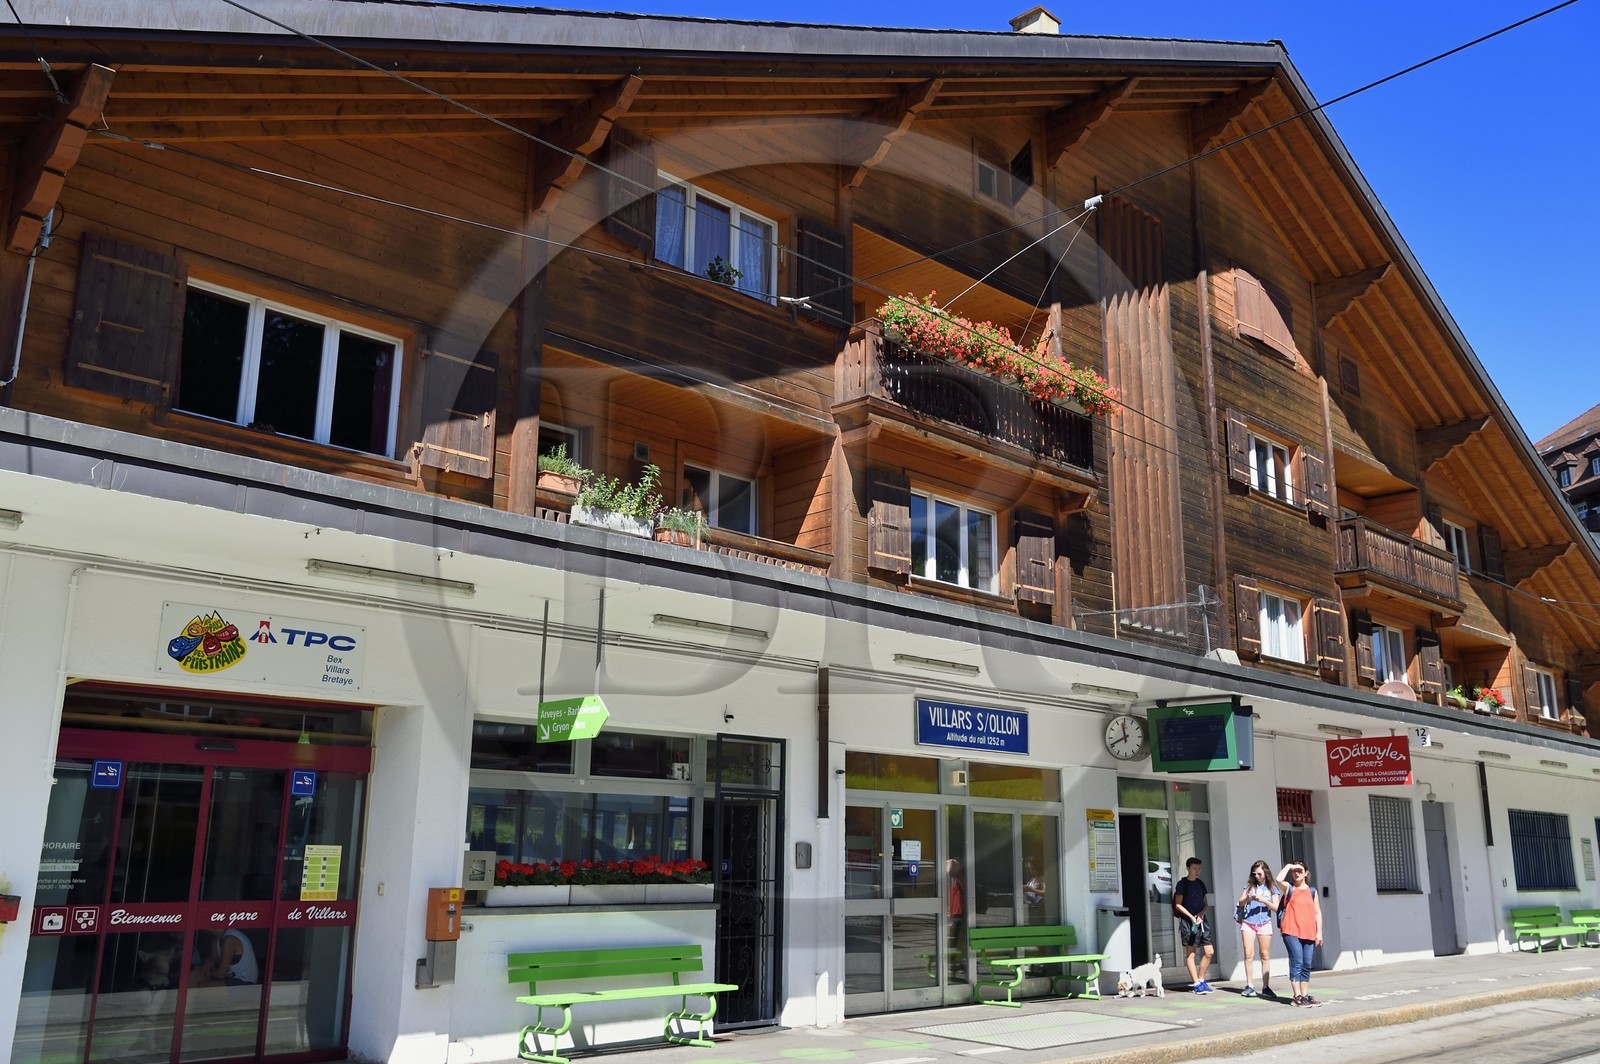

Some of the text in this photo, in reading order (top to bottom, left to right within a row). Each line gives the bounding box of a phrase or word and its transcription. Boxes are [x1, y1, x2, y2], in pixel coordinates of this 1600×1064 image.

[209, 619, 223, 632] PAYS
[281, 628, 356, 651] TPC
[193, 648, 205, 658] DES
[327, 654, 343, 664] Bex
[325, 664, 350, 675] Villars
[321, 674, 353, 686] Bretaye
[540, 709, 563, 720] Arveyes
[928, 706, 1020, 736] VILLARS S/OLLON
[552, 722, 570, 734] Gryon
[1415, 728, 1426, 737] 12
[946, 732, 968, 743] Altitude
[968, 735, 976, 743] du
[976, 735, 986, 745] rail
[987, 736, 1000, 746] 1252
[1421, 737, 1427, 746] 3
[1329, 742, 1406, 766] Dätwyler
[1355, 760, 1383, 768] SPORTS
[42, 842, 81, 850] HORAIRE
[210, 911, 226, 923] en
[228, 910, 259, 926] gare
[287, 908, 303, 921] de
[305, 905, 348, 921] Villars
